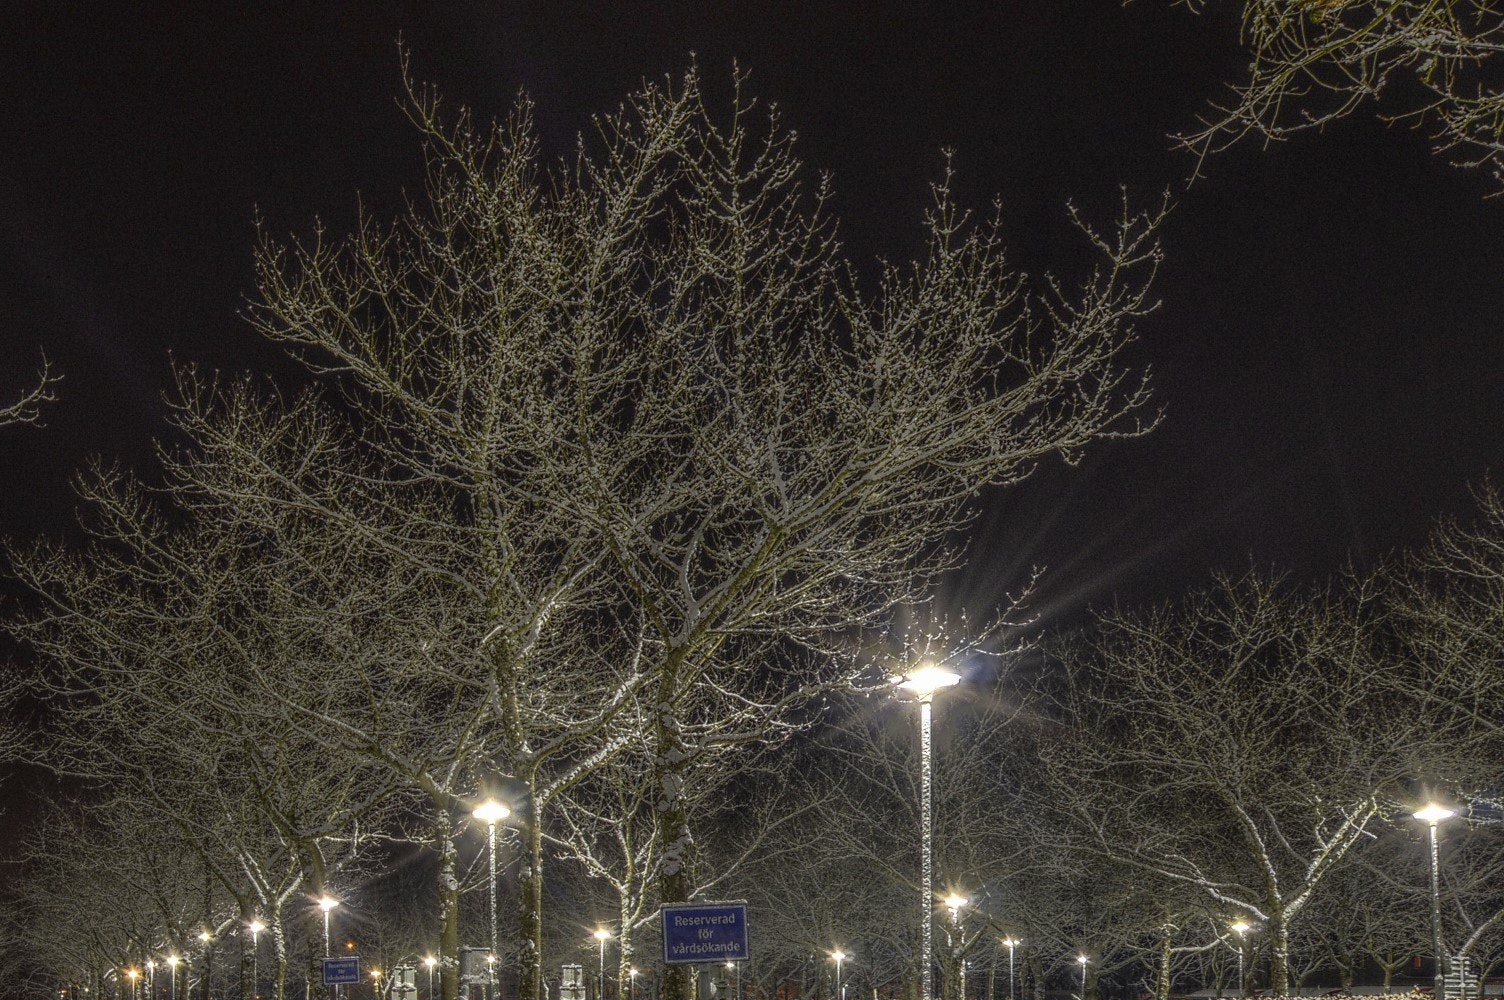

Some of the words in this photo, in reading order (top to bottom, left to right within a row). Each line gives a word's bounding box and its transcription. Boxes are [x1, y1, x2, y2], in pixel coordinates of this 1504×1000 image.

[674, 913, 736, 927] Reserverad
[697, 928, 714, 940] för
[672, 941, 741, 954] vårdsökande
